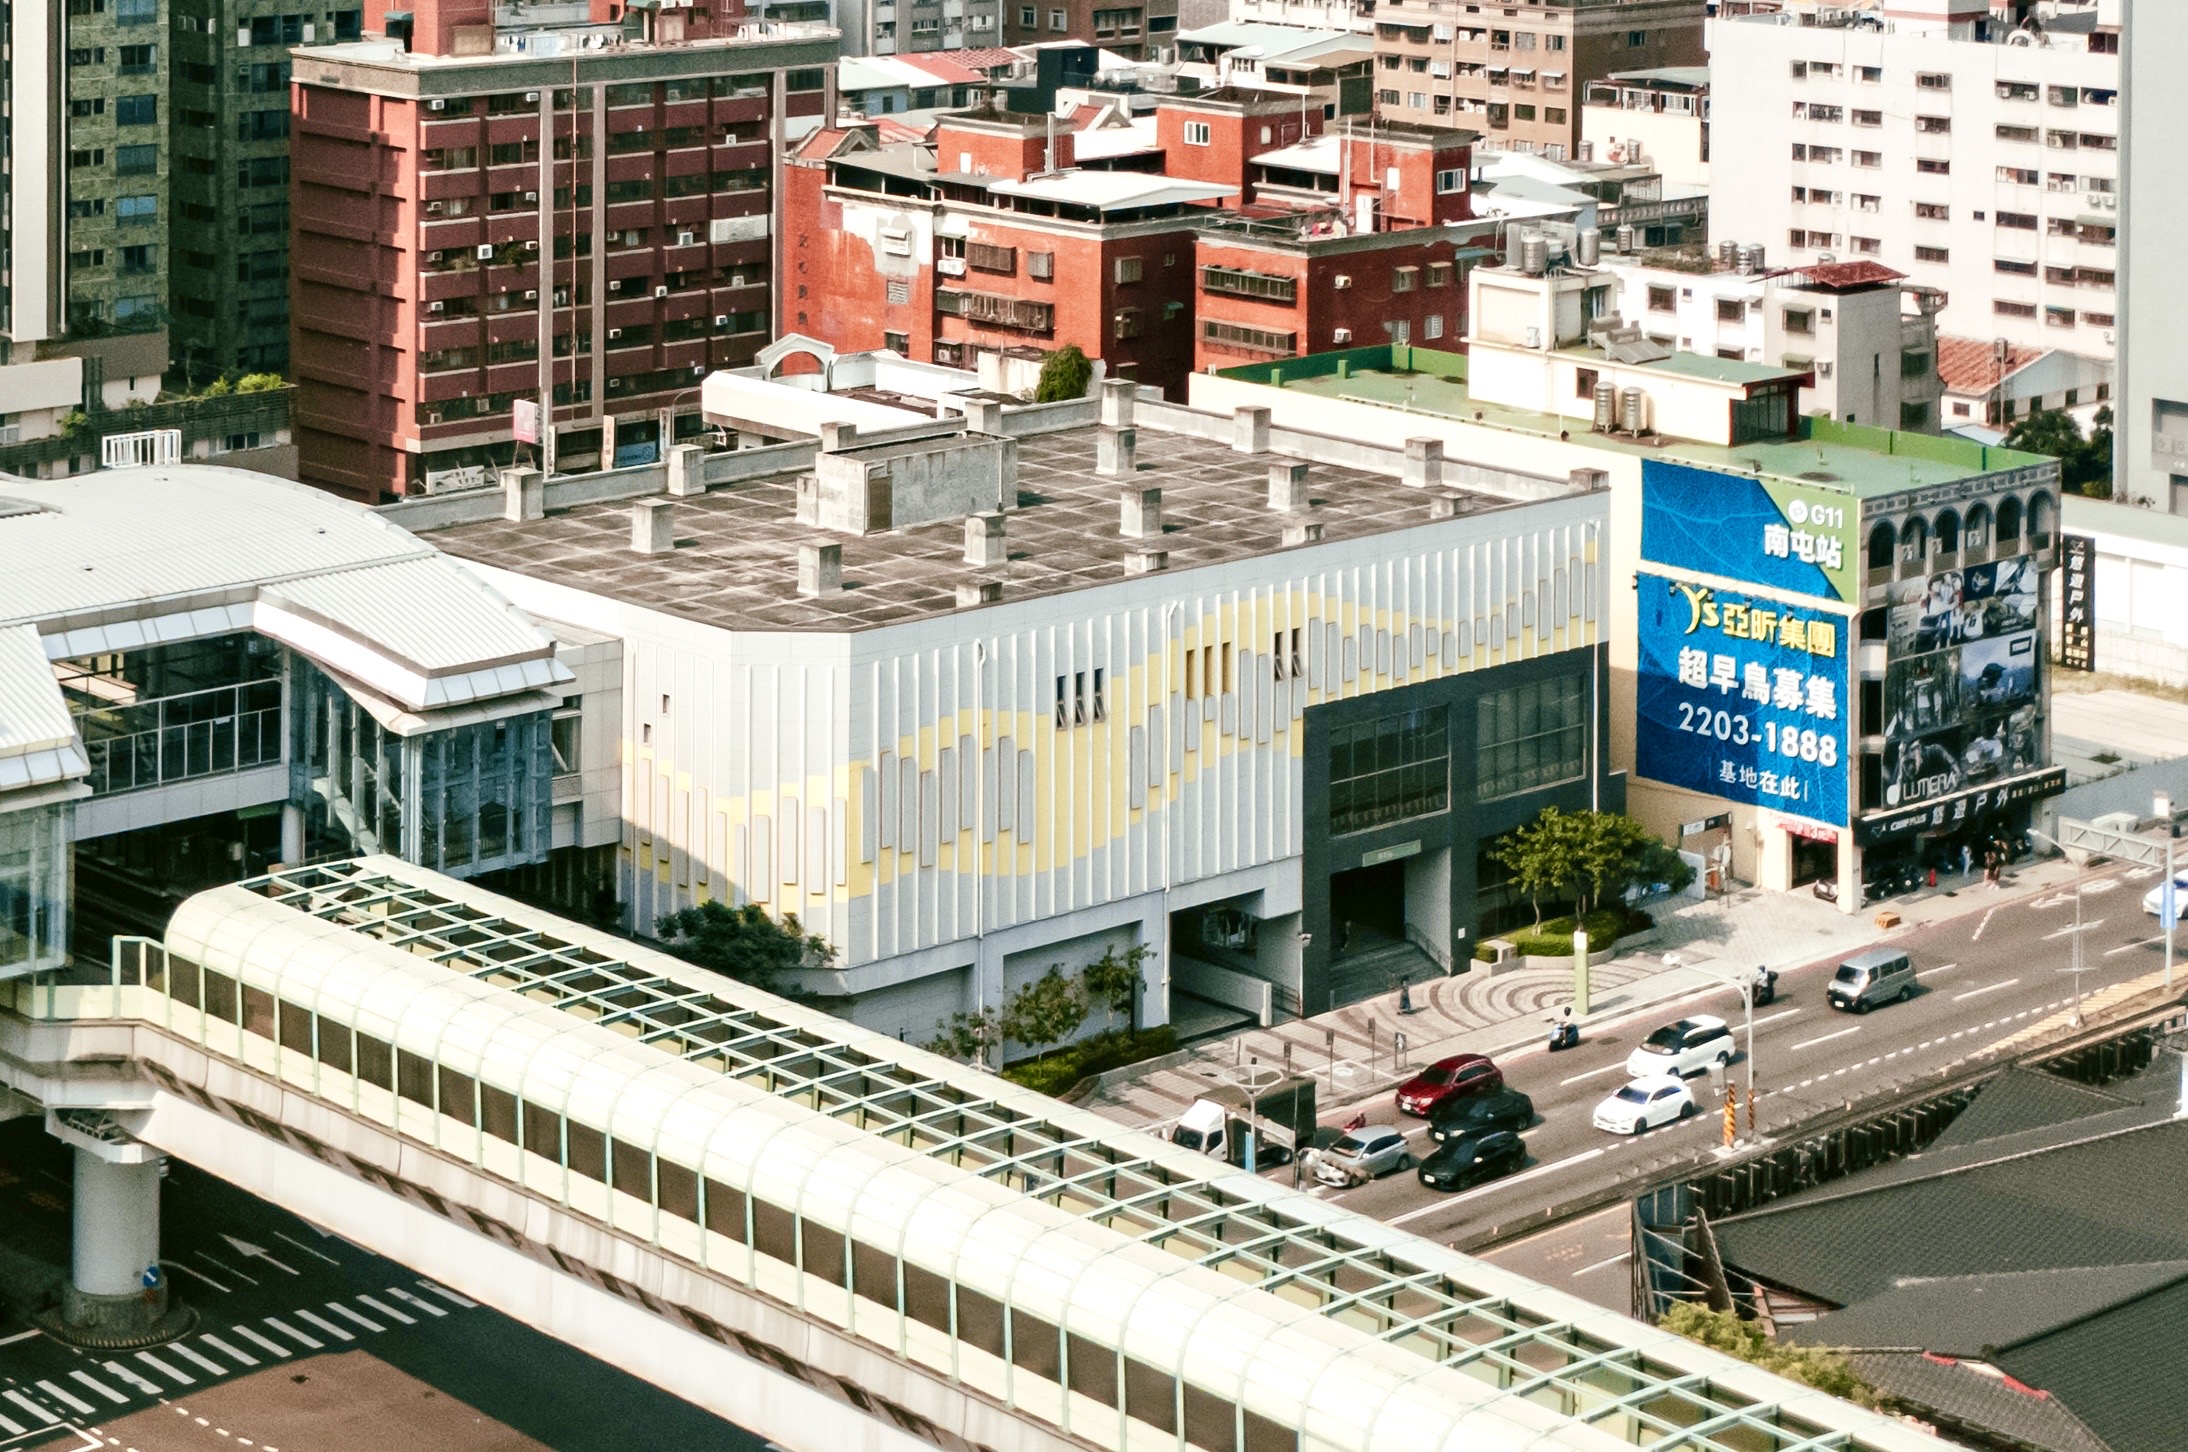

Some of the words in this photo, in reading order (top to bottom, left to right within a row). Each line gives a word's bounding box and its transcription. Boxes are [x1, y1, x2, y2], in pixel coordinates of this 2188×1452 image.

[1811, 504, 1844, 529] G11
[1764, 523, 1843, 570] 南屯站
[1723, 602, 1836, 658] 亞昕集團
[1678, 646, 1837, 720] 超早鳥募集
[1678, 702, 1838, 767] 2203-1888
[1718, 759, 1801, 800] 基地在此
